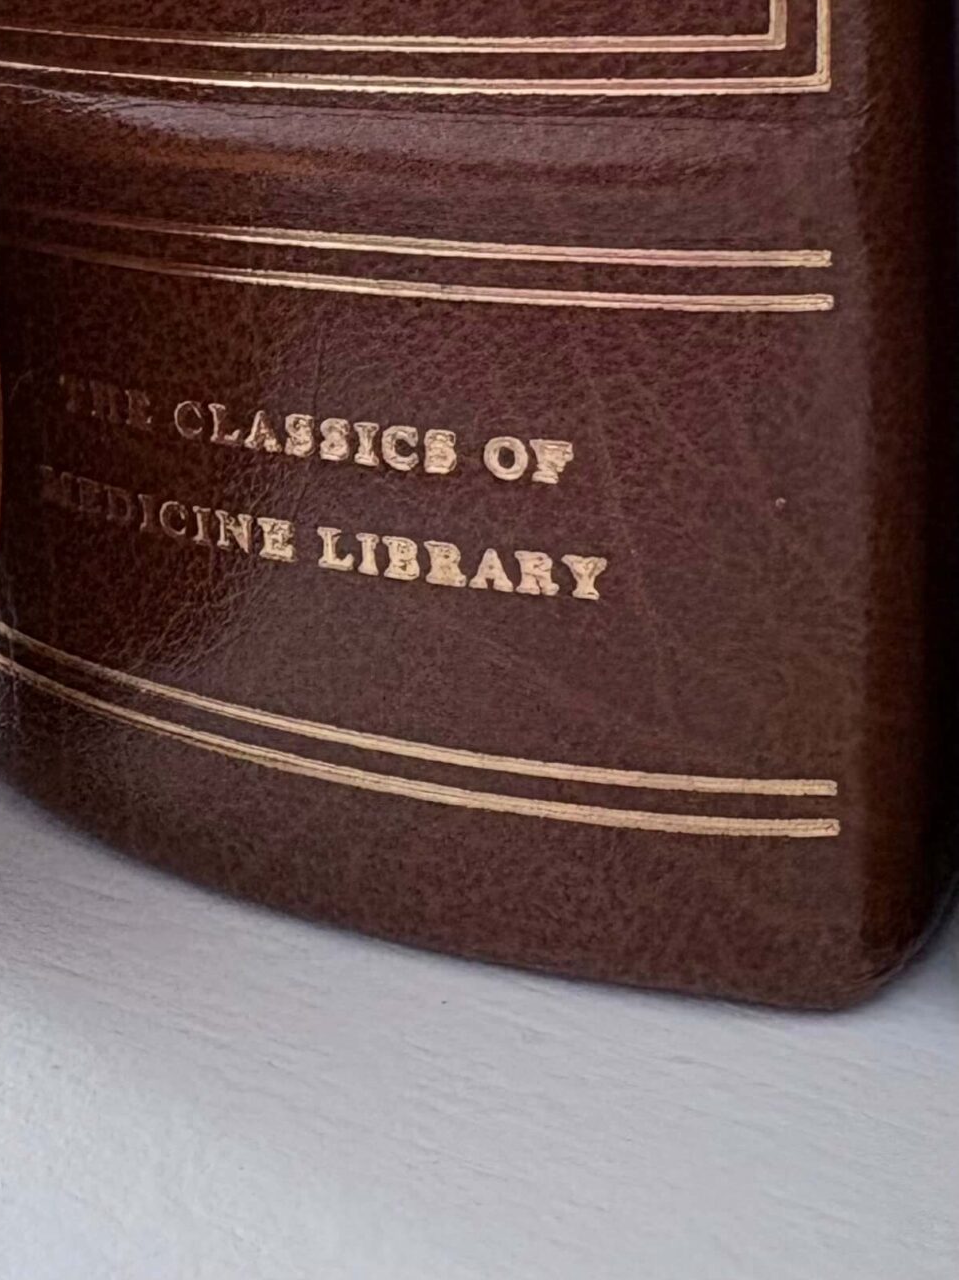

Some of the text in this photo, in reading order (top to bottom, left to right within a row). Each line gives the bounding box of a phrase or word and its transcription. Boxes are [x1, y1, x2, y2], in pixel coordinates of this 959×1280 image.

[173, 400, 456, 474] CLASSICS
[483, 436, 573, 483] OF
[317, 526, 607, 600] LIBRARY
